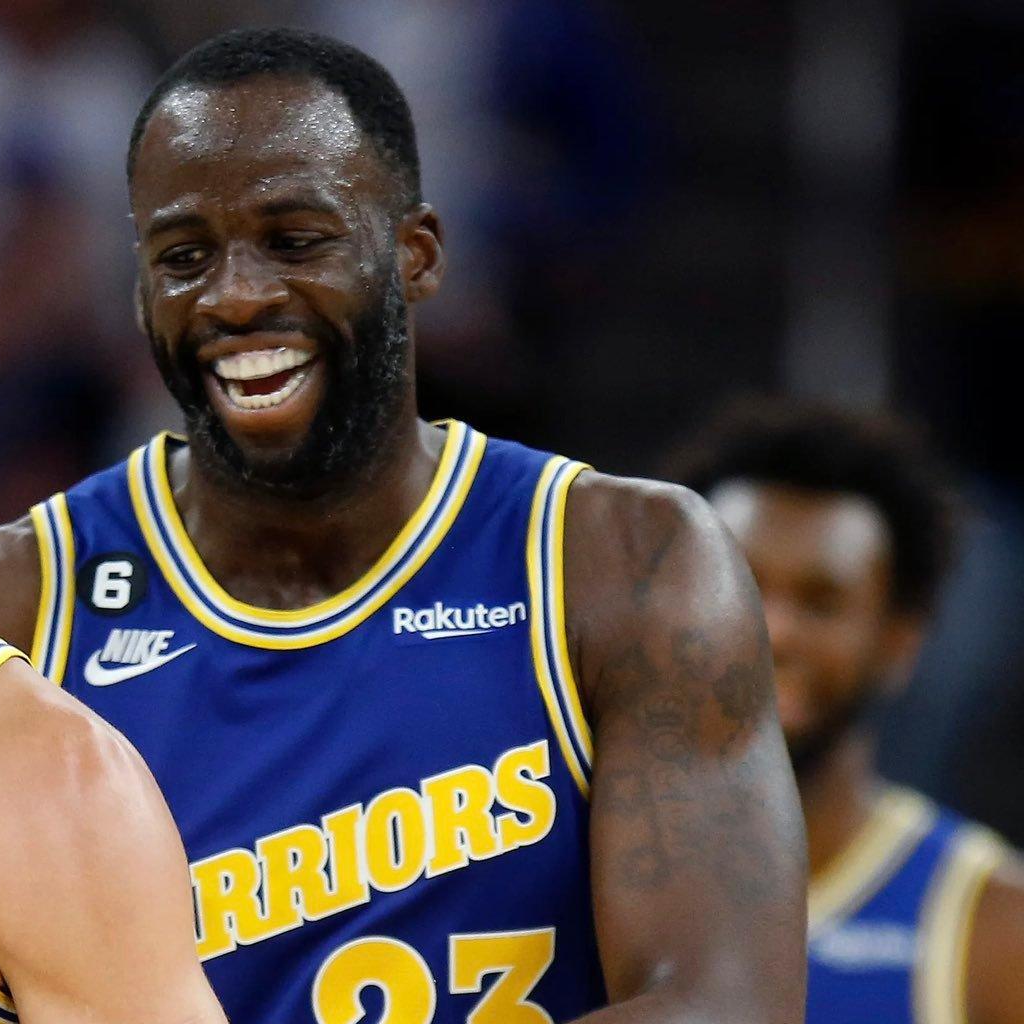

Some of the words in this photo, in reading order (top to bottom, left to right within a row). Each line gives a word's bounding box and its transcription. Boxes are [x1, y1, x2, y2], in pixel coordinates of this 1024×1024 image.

[92, 560, 134, 610] 6
[392, 601, 527, 635] Rakuten
[98, 628, 176, 665] NIKE
[188, 740, 557, 963] RRIORS
